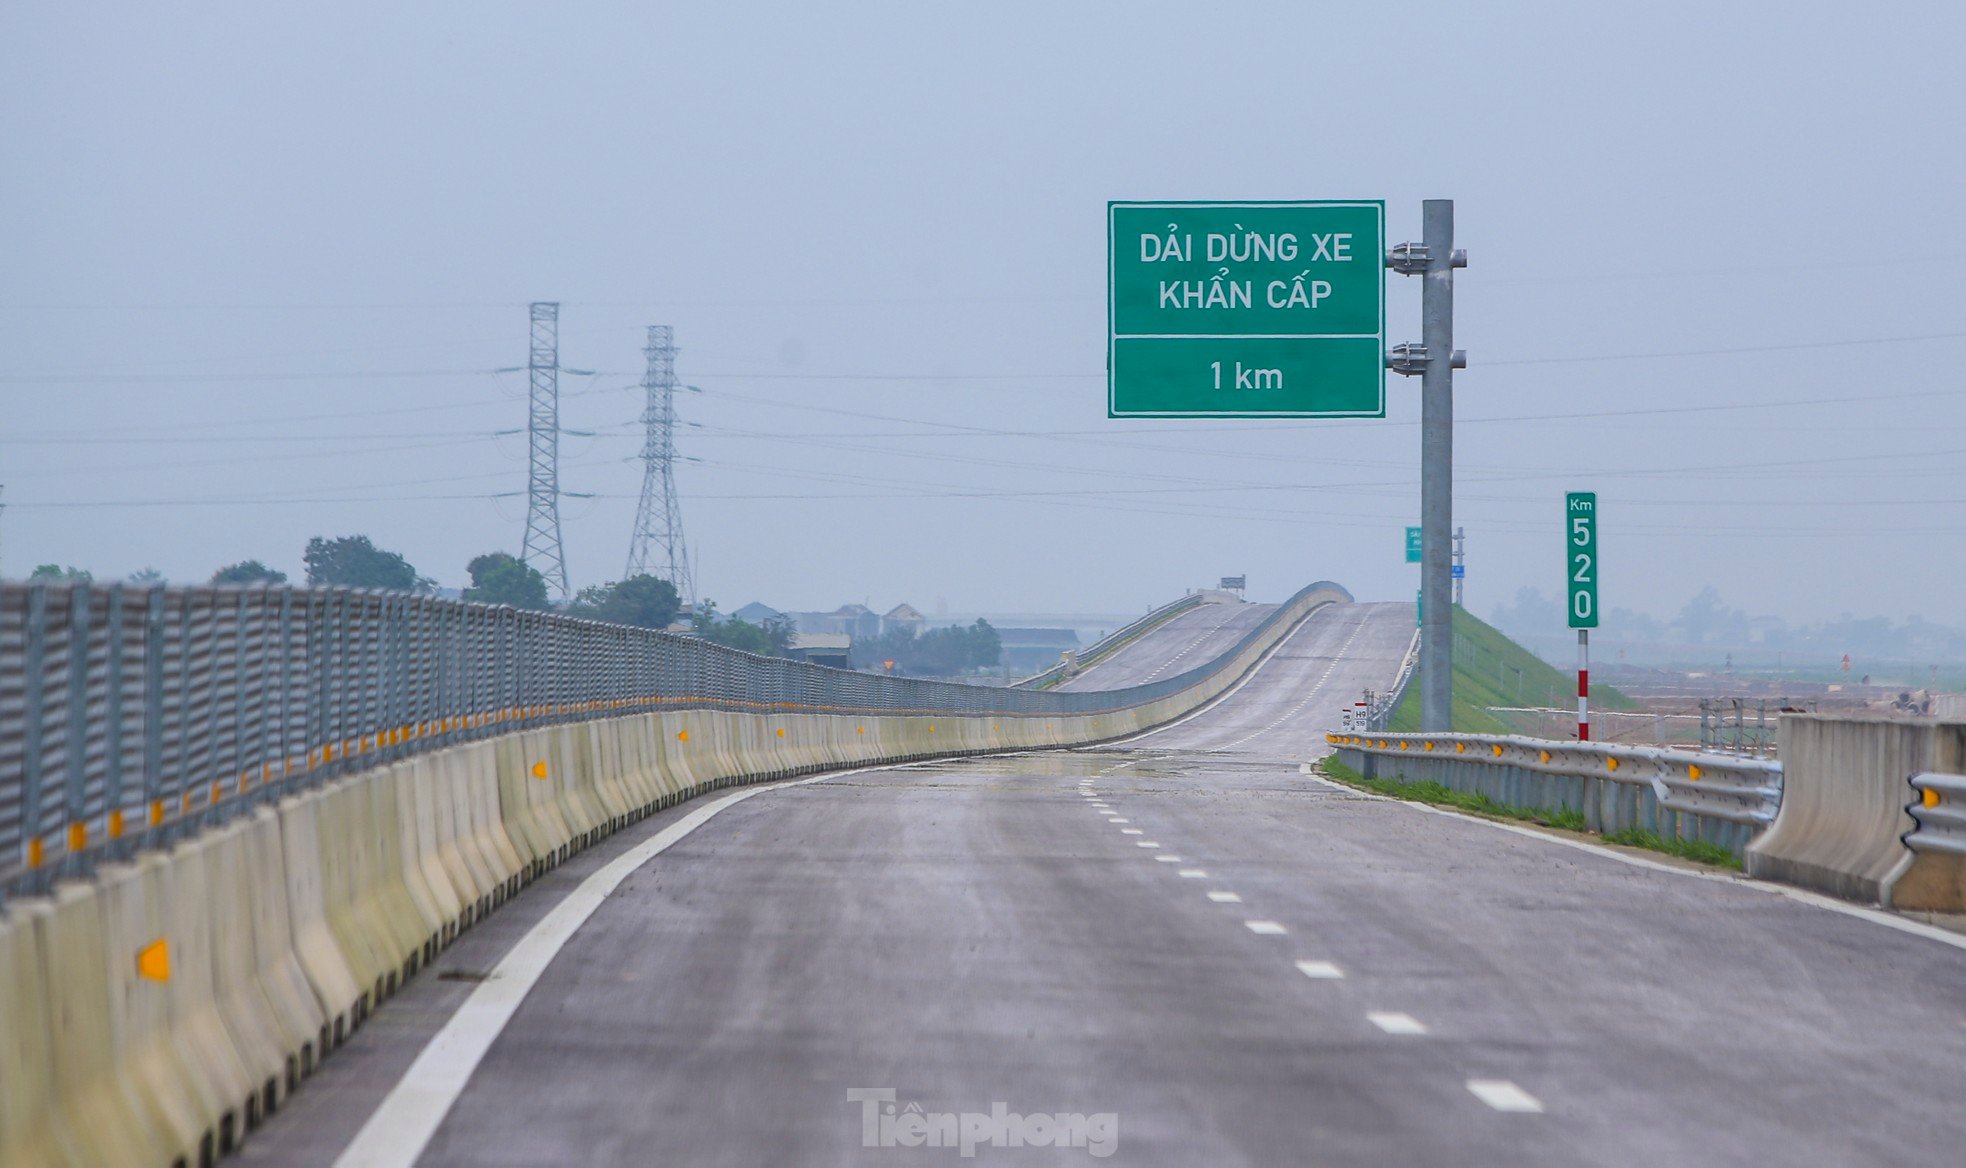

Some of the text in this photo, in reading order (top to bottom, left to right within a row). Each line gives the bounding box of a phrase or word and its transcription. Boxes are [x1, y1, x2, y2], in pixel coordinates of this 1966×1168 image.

[1141, 223, 1353, 262] DẢI DỪNG XE
[1160, 267, 1332, 309] KHẨN CẤP
[1211, 361, 1283, 389] 1 km
[1570, 499, 1592, 511] Km
[1573, 518, 1592, 618] 520
